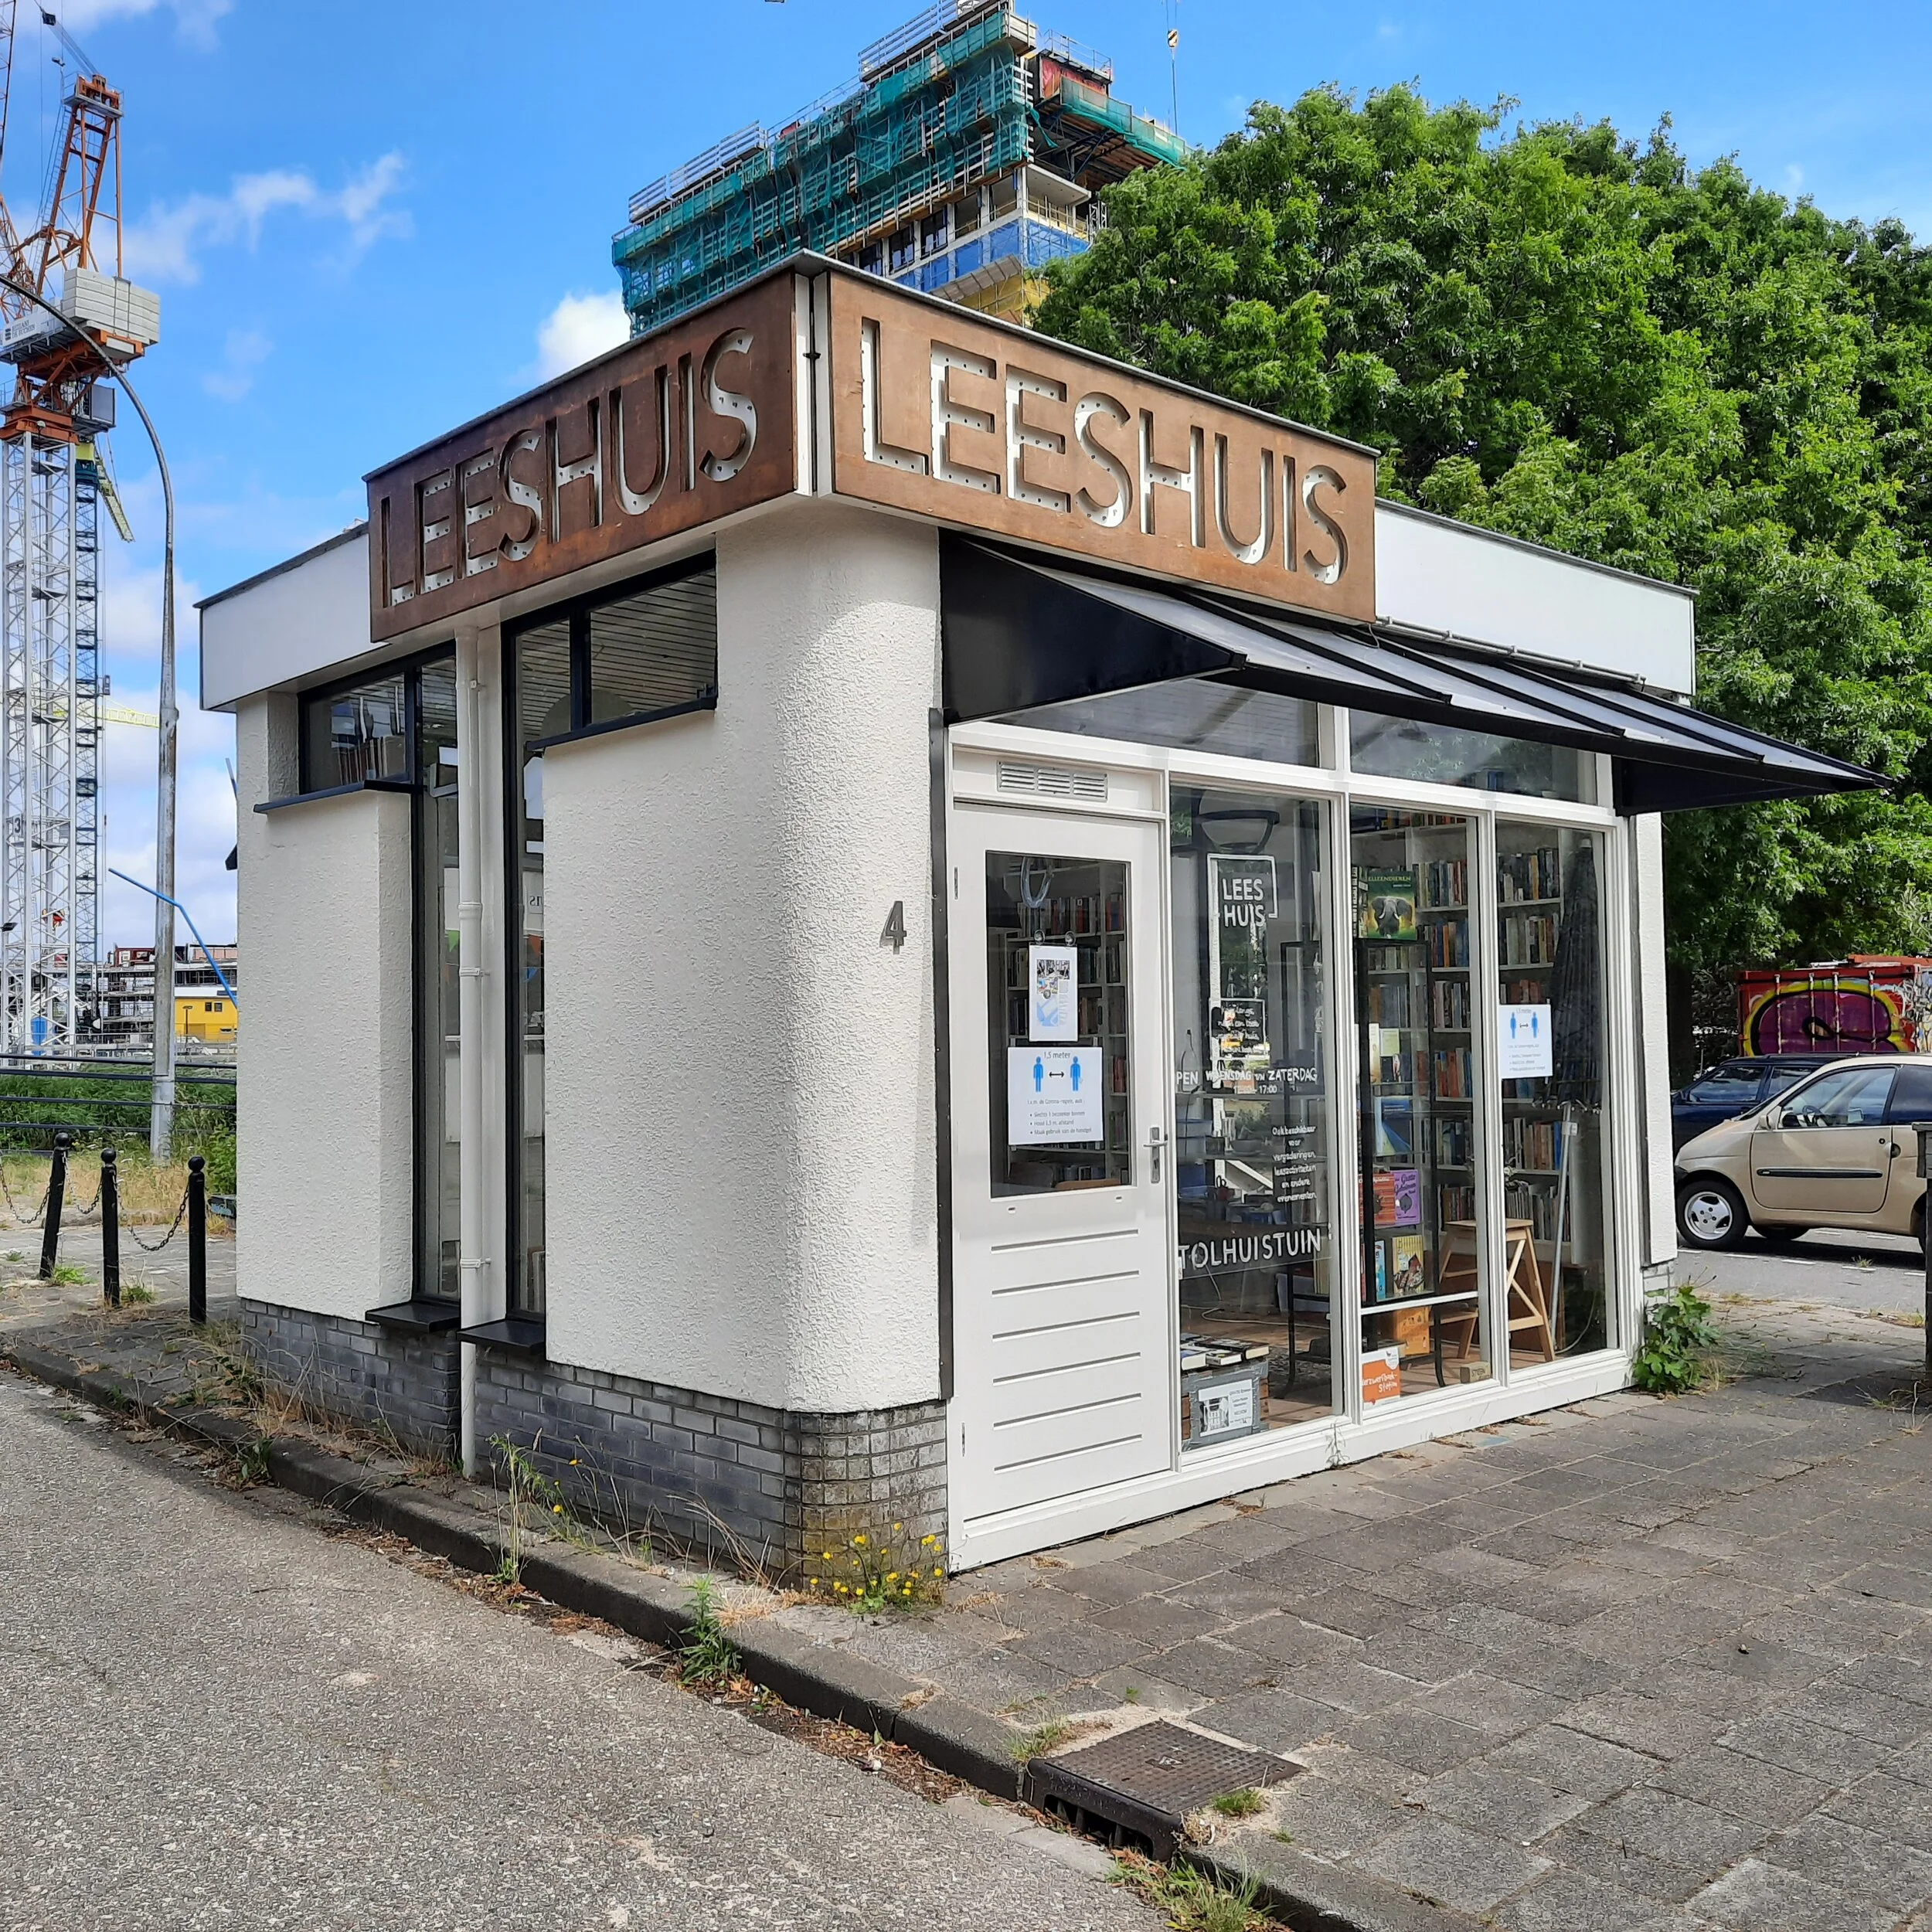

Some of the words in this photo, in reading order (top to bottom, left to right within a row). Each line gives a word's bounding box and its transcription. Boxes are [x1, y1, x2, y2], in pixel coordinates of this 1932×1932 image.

[862, 318, 1348, 585] LEESHUIS
[381, 327, 758, 607] LEESHUIS
[1223, 879, 1264, 900] LEES
[885, 900, 907, 947] 4
[1224, 904, 1265, 927] HUIS
[1176, 1071, 1198, 1085] PEN
[1206, 1070, 1252, 1080] WENSDAG
[1268, 1068, 1318, 1083] ZATERDAG
[1259, 1084, 1277, 1094] 17:00
[1291, 1178, 1311, 1188] andere
[1179, 1228, 1321, 1269] TOLHUISTUIN
